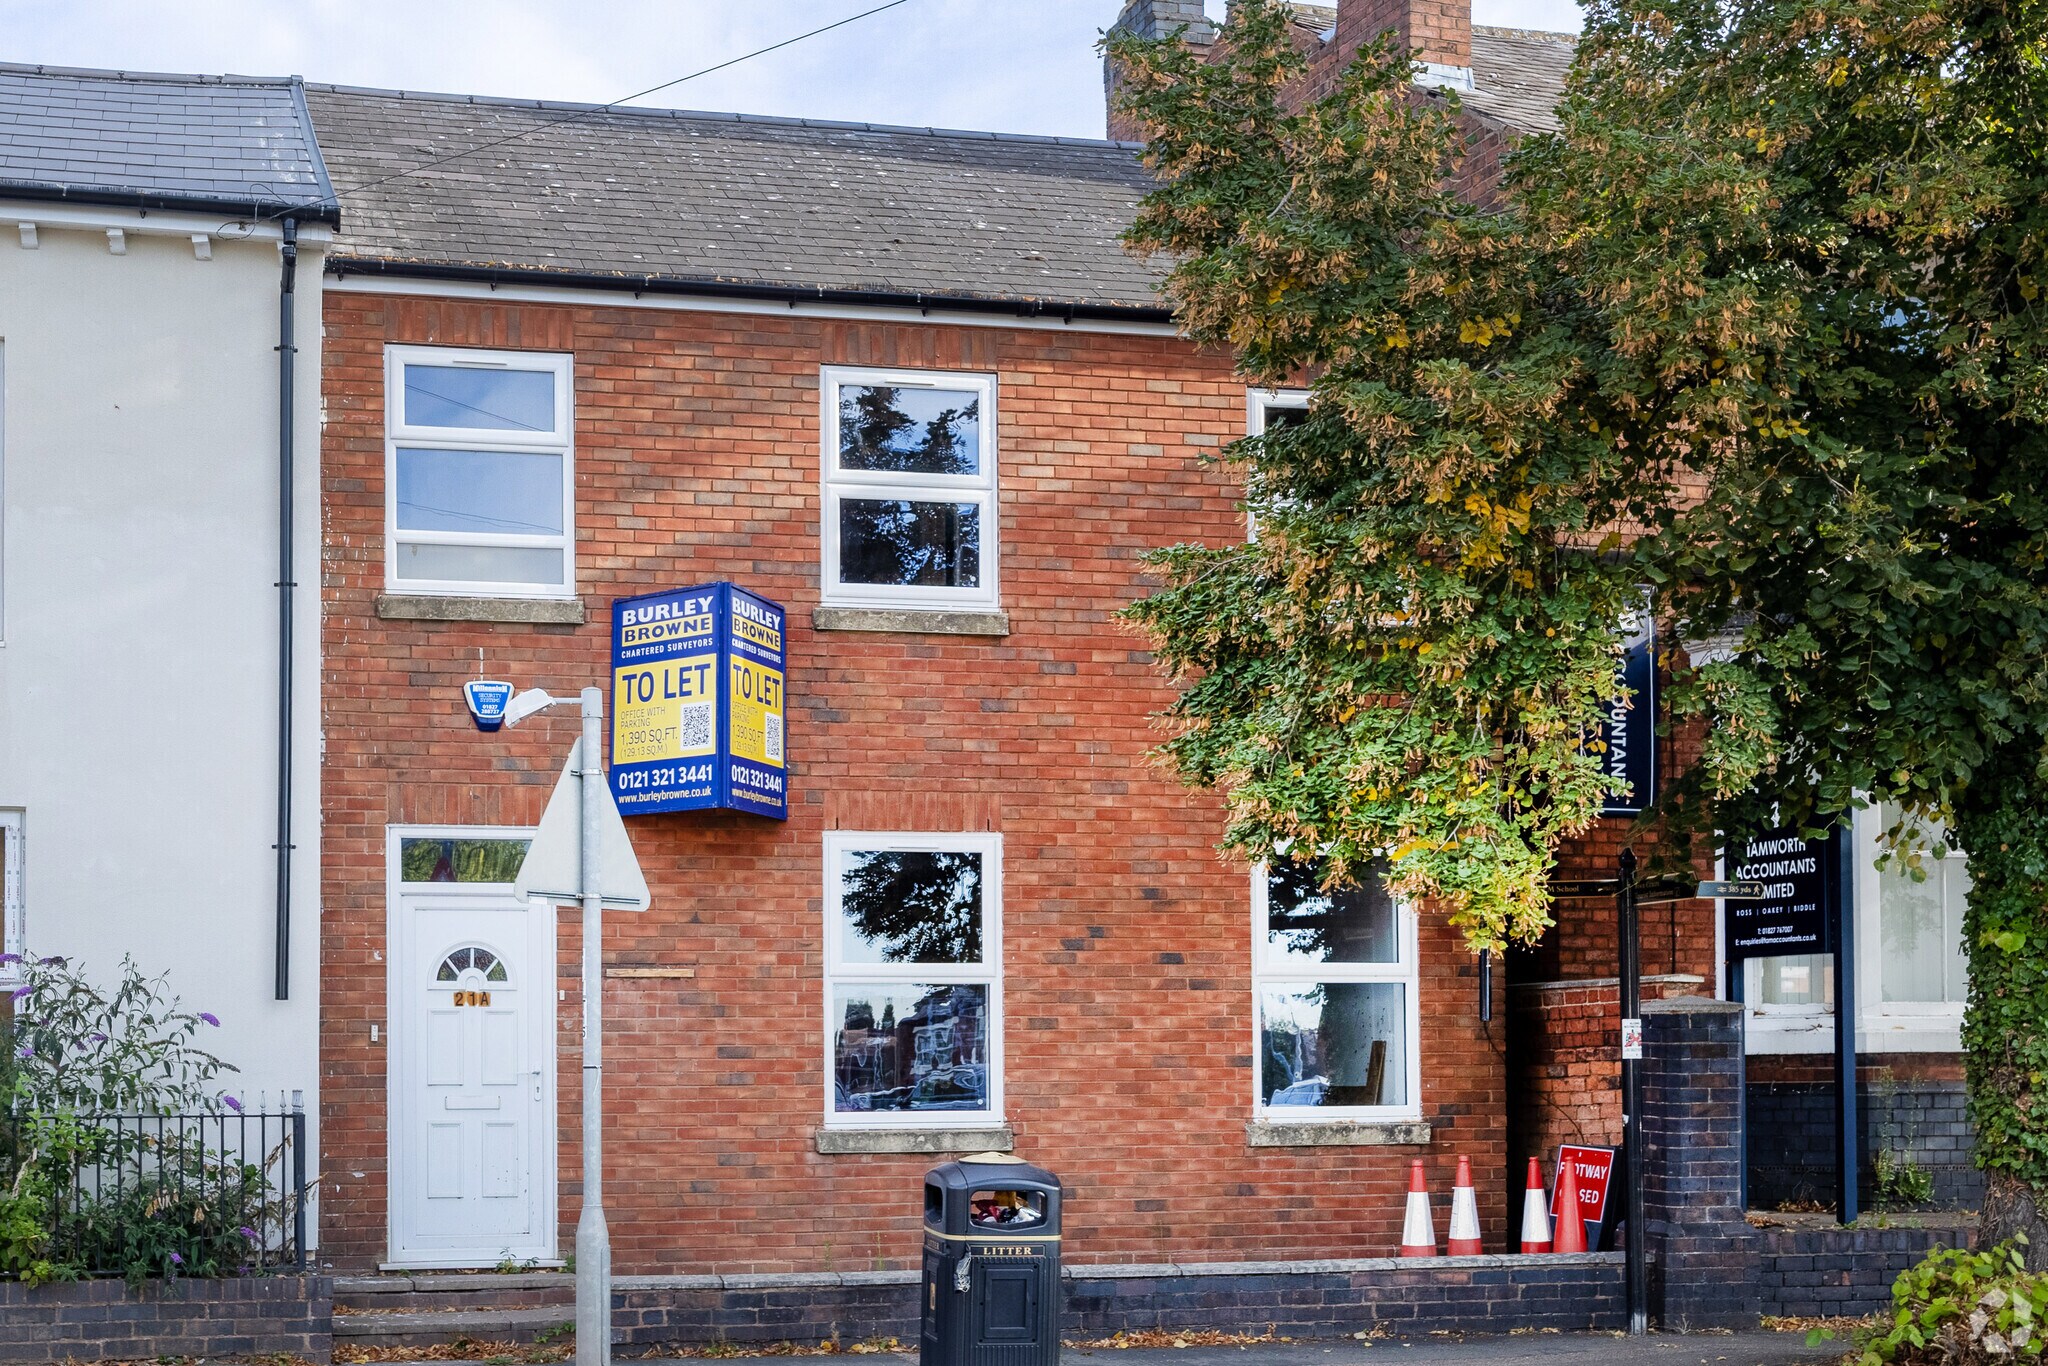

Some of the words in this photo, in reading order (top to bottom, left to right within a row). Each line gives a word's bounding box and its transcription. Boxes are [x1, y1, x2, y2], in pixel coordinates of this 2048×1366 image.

[622, 596, 714, 626] BURLEY
[732, 596, 781, 631] BURLEY
[624, 617, 711, 643] BROWNE
[733, 618, 780, 648] BROWNE
[621, 645, 665, 659] CHARTERED
[667, 637, 713, 652] SURVEYORS
[731, 637, 757, 655] CHARTERED
[757, 647, 782, 664] SURVEYORS
[622, 671, 655, 704] TO
[663, 663, 711, 699] LET
[733, 663, 752, 699] TO
[756, 671, 780, 709] LET
[620, 708, 645, 720] OFFICE
[647, 706, 666, 717] WITH
[620, 717, 651, 730] PARKING
[618, 770, 649, 790] 0121
[651, 767, 675, 787] 321
[678, 763, 713, 784] 3441
[731, 764, 749, 785] 0121
[750, 768, 764, 788] 321
[764, 772, 783, 793] 3441
[618, 785, 712, 803] www.burleybrowne.co.uk
[731, 787, 782, 808] www.burleybrowne.co.uk
[1735, 857, 1817, 880] ACCOUNTANTS
[1556, 884, 1580, 893] School
[1727, 884, 1739, 893] 385
[1739, 884, 1752, 896] yds
[1736, 908, 1753, 917] ROSS
[1761, 905, 1784, 915] OAKEY
[1793, 903, 1816, 912] BIDDLE
[982, 1246, 1032, 1256] LITTER
